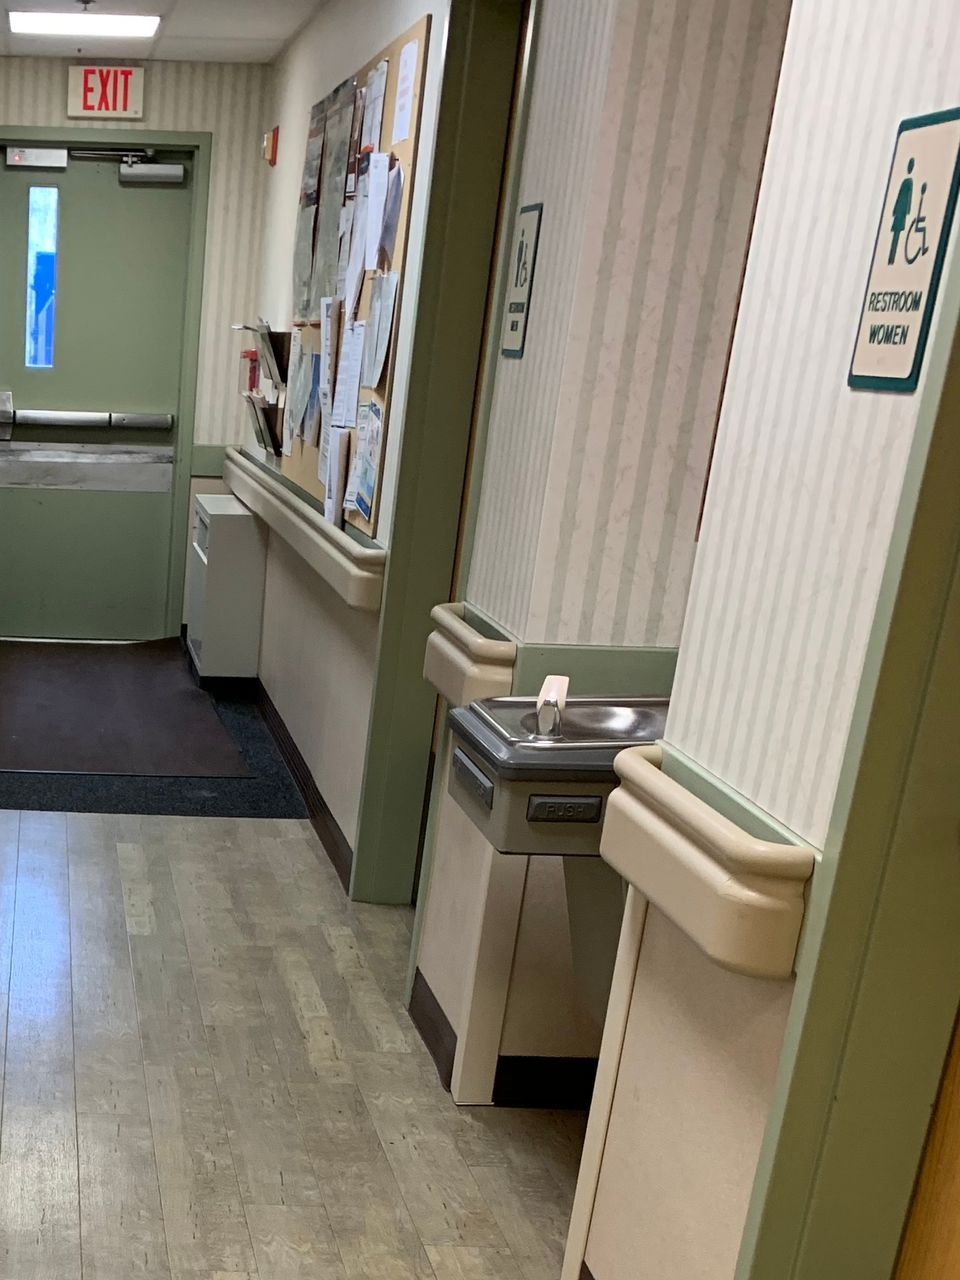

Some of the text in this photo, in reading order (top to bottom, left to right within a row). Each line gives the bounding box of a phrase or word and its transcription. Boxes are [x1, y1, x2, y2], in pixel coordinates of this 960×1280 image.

[82, 68, 133, 112] EXIT
[868, 291, 923, 312] RESTROOM
[869, 324, 910, 346] WOMEN
[545, 803, 585, 817] PUSH
